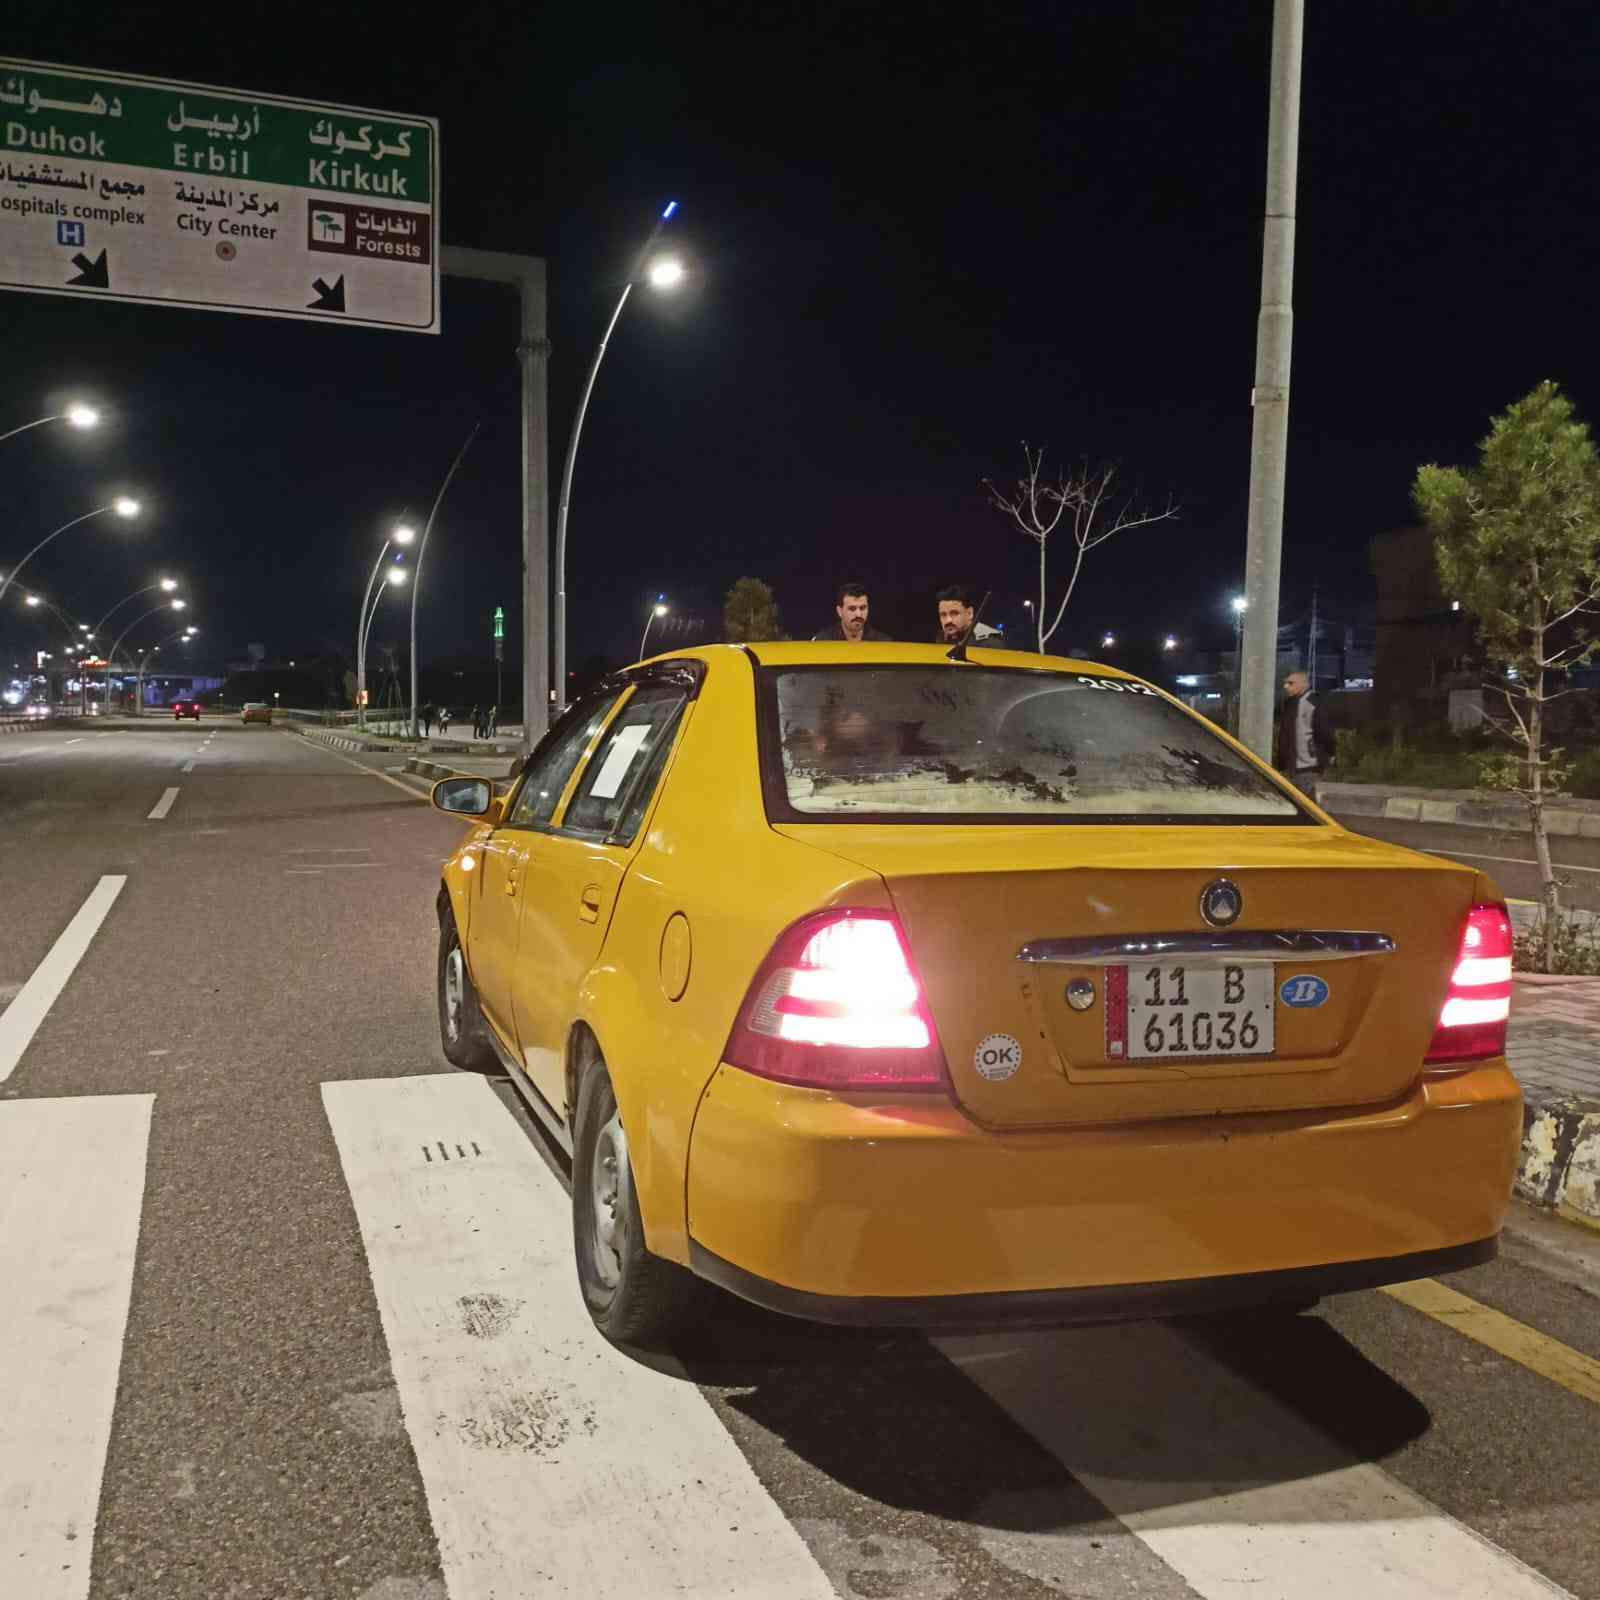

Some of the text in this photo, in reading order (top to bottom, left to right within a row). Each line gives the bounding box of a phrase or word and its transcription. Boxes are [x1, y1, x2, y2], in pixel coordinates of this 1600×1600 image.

[167, 100, 260, 141] أربيل
[7, 121, 105, 156] Duhok
[309, 119, 412, 160] كركوك
[174, 143, 249, 175] Erbil
[99, 179, 145, 200] مجمع
[309, 158, 408, 196] Kirkuk
[0, 196, 145, 226] ospitals complex
[174, 180, 279, 217] مركز المدينة
[177, 213, 277, 240] City Center
[355, 212, 417, 237] الغابات
[356, 235, 421, 257] Forests
[1077, 676, 1158, 696] 2012
[1145, 966, 1245, 1006] 11 B
[1144, 1011, 1259, 1053] 61036
[982, 1047, 1013, 1065] OK
